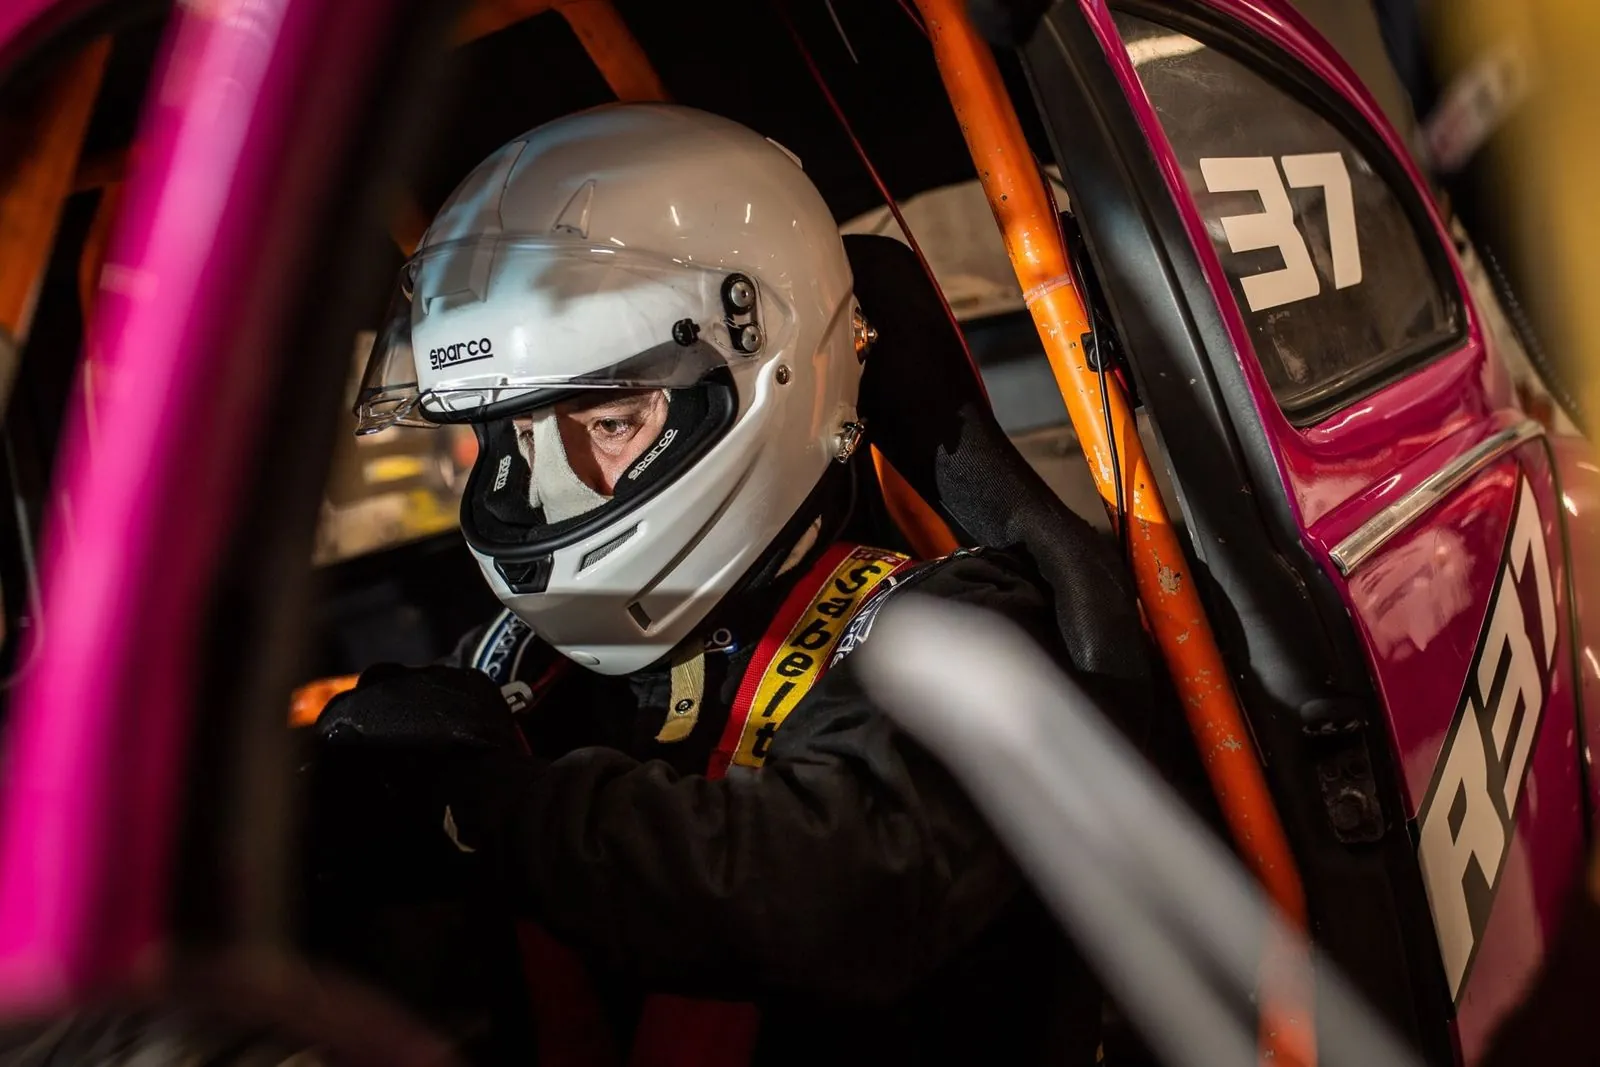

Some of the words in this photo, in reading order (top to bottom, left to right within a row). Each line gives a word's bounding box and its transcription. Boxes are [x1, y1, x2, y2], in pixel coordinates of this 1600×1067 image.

[1200, 152, 1362, 312] 37
[430, 338, 492, 370] sparco
[628, 429, 676, 480] sparco
[751, 564, 882, 758] Sabelt
[1418, 475, 1557, 1002] R37
